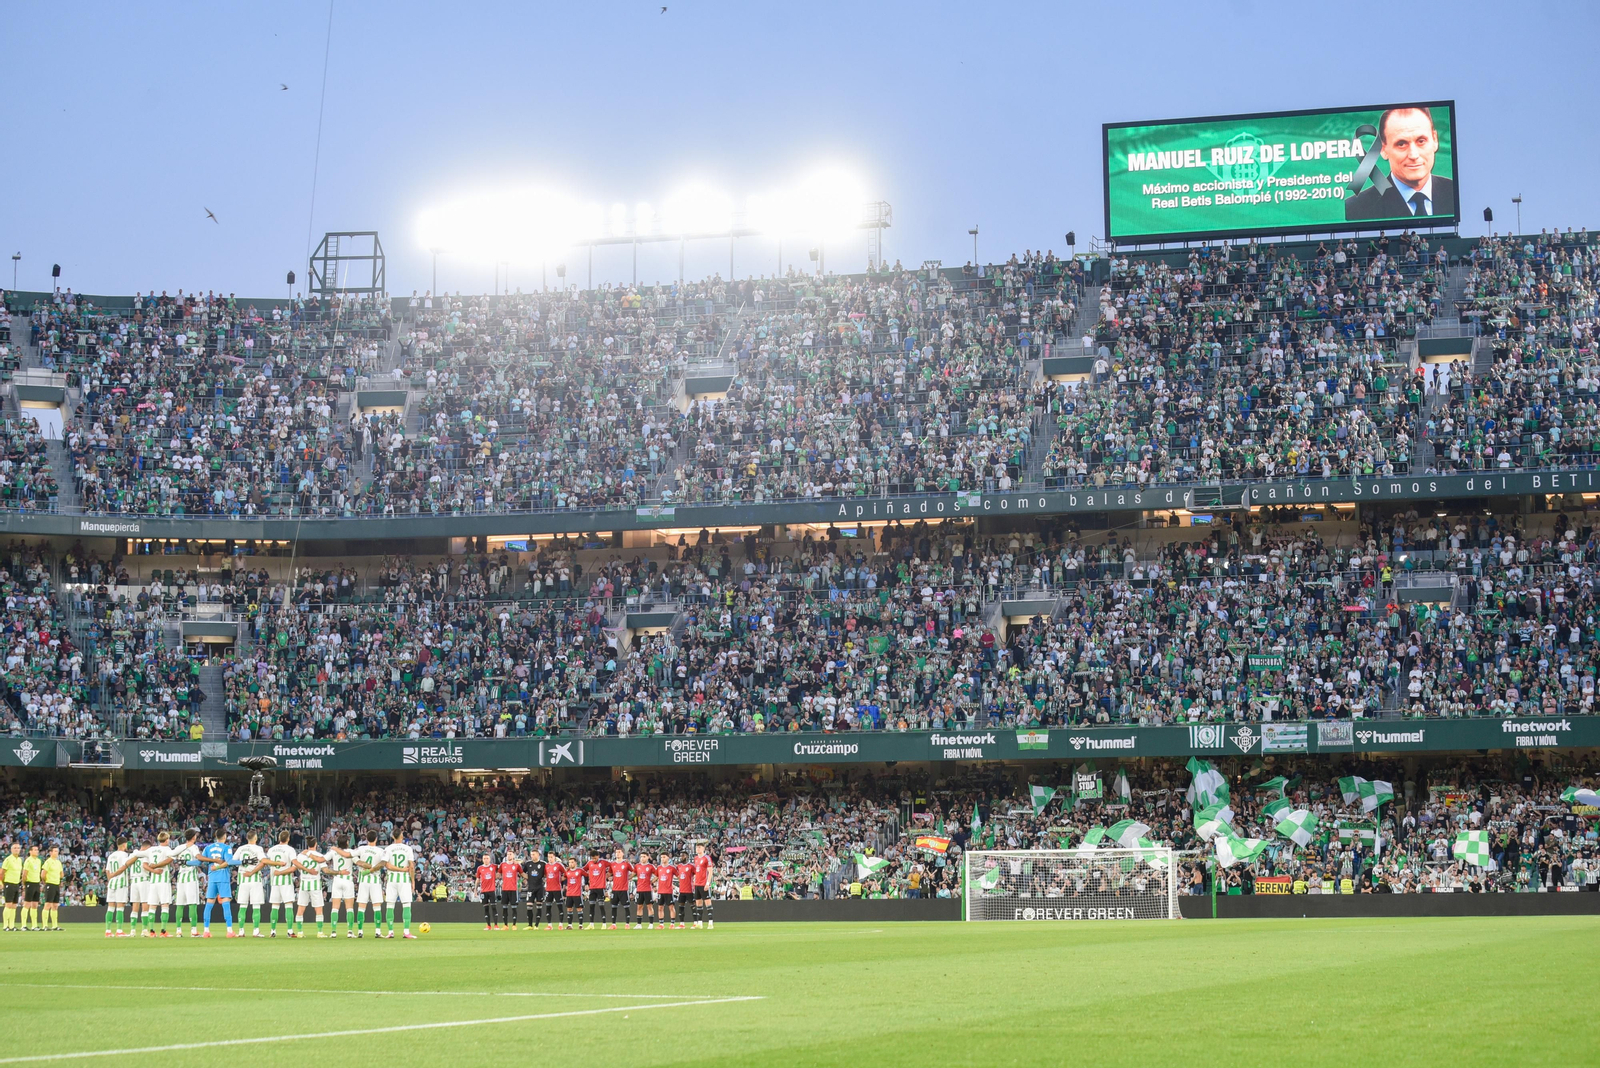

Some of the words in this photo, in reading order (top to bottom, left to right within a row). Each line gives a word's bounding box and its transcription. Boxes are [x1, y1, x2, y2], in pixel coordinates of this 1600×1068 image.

[1128, 148, 1206, 171] MANUEL
[1211, 146, 1254, 166] RUIZ
[1260, 144, 1285, 163] DE
[1291, 139, 1364, 161] LOPERA
[1142, 180, 1190, 195] Máximo
[1192, 178, 1254, 192] accionista
[1257, 180, 1265, 191] y
[1267, 173, 1331, 188] Presidente
[1334, 171, 1353, 184] del
[1151, 196, 1178, 209] Real
[1181, 194, 1212, 207] Betis
[1214, 191, 1271, 206] Balompié
[1274, 187, 1345, 204] (1992-2010)
[838, 500, 961, 517] Apiñados
[984, 497, 1046, 510] como
[1069, 493, 1142, 506] balas
[1354, 481, 1437, 495] Somos
[1466, 477, 1506, 490] del
[80, 521, 140, 533] Manquepierda
[1501, 718, 1572, 732] finetwork
[930, 732, 996, 745] finetwork
[1086, 736, 1136, 749] hummel
[1373, 729, 1424, 743] hummel
[1516, 736, 1534, 746] FIBRA
[1534, 735, 1538, 746] Y
[1539, 734, 1558, 745] MÓVIL
[273, 744, 335, 756] finetwork
[420, 747, 463, 756] REALE
[665, 739, 719, 751] FOREVER
[794, 741, 858, 756] Cruzcampo
[156, 750, 201, 763] hummel
[673, 751, 710, 763] GREEN
[943, 749, 960, 758] FIBRA
[961, 748, 965, 758] Y
[965, 747, 983, 758] MÓVIL
[301, 759, 306, 768] Y
[306, 757, 323, 768] MÓVIL
[420, 756, 463, 764] SEGUROS
[109, 861, 119, 873] 10
[133, 859, 142, 874] 18
[392, 853, 406, 869] 12
[1255, 882, 1290, 894] GERENA
[1015, 907, 1086, 920] FOREVER
[1088, 907, 1134, 919] GREEN
